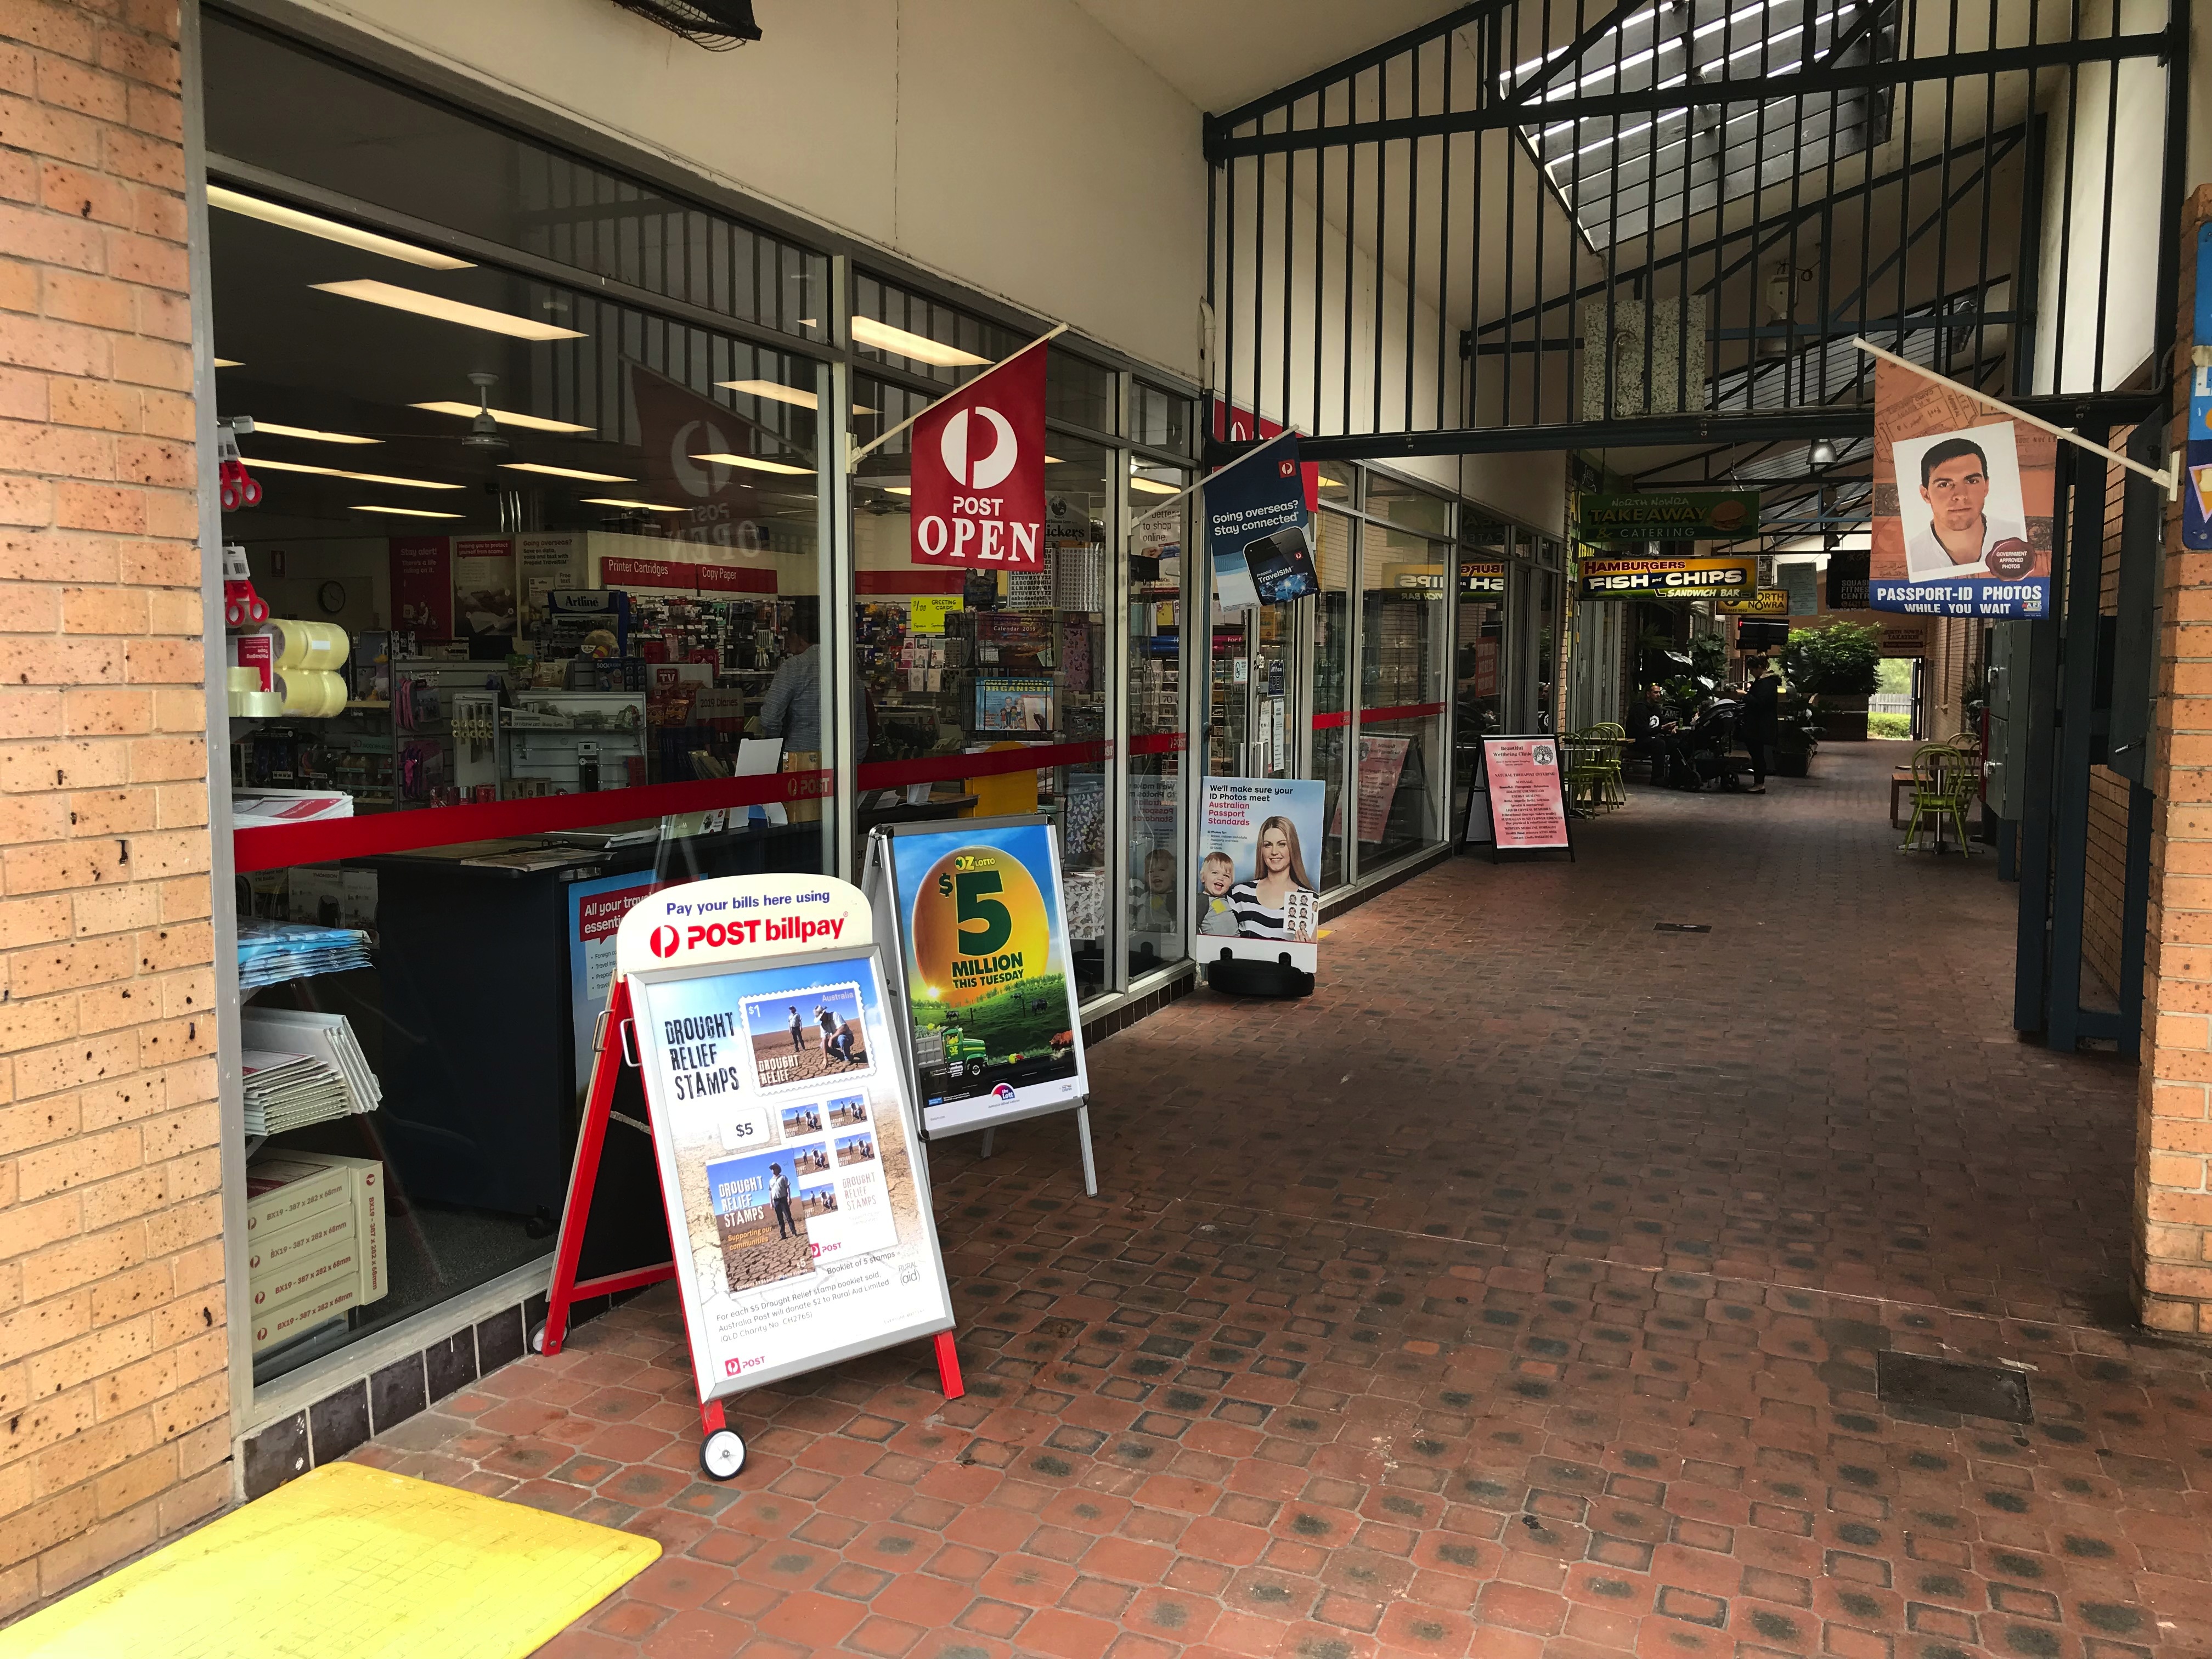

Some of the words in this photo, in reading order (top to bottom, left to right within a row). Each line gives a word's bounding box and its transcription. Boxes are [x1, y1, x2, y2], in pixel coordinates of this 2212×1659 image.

[953, 496, 1003, 516] POST
[1612, 498, 1647, 507] NORTH
[1651, 496, 1689, 506] NOWRA
[1212, 511, 1243, 524] Going
[1245, 500, 1299, 518] overseas?
[1153, 522, 1172, 531] shop
[1215, 524, 1239, 536] Stay
[1596, 527, 1613, 539] &
[1620, 527, 1695, 538] CATERING
[917, 515, 1040, 563] OPEN
[1143, 533, 1168, 542] online.
[400, 549, 416, 557] Stay
[608, 560, 632, 572] Printer
[634, 561, 668, 577] Cartridges
[702, 567, 718, 580] Copy
[720, 569, 736, 580] Paper
[1258, 567, 1292, 583] TravelSIM
[1584, 561, 1685, 574] HAMBURGERS
[1588, 574, 1649, 590] FISH
[1665, 571, 1742, 585] CHIPS
[1667, 589, 1717, 597] SANDWICH
[1720, 589, 1740, 597] BAR
[1877, 587, 1973, 601] PASSPORT-ID
[1983, 585, 2042, 601] PHOTOS
[566, 596, 599, 607] Artline
[1748, 600, 1784, 610] NOWRA
[1904, 603, 1941, 613] WHILE
[1948, 603, 1972, 613] YOU
[1979, 603, 2011, 614] WAIT
[659, 674, 675, 682] TV
[701, 698, 715, 707] 2019
[717, 697, 738, 707] Diaries
[800, 777, 830, 794] POST
[955, 856, 975, 871] OZ
[975, 857, 996, 867] LOTTO
[585, 902, 597, 917] All
[600, 900, 622, 916] your
[667, 902, 692, 916] Pay
[698, 901, 728, 915] your
[732, 896, 759, 909] bills
[764, 894, 792, 906] here
[796, 891, 830, 905] using
[688, 919, 761, 950] POST
[766, 916, 844, 943] billpay
[951, 952, 1024, 979] MILLION
[953, 978, 978, 989] THIS
[980, 969, 1024, 986] TUESDAY
[822, 991, 854, 1002] Australia
[748, 1005, 760, 1018] $1
[665, 1012, 736, 1044] DROUGHT
[670, 1043, 717, 1070] RELIEF
[759, 1054, 799, 1071] DROUGHT
[675, 1066, 740, 1101] STAMPS
[760, 1071, 790, 1085] RELIEF
[736, 1122, 753, 1137] $5
[719, 1176, 764, 1198] DROUGHT
[842, 1172, 876, 1189] DROUGHT
[845, 1186, 867, 1199] RELIEF
[267, 1209, 284, 1221] BX19
[289, 1202, 301, 1212] 387
[307, 1196, 318, 1205] 282
[324, 1186, 342, 1197] 68mm
[721, 1194, 752, 1212] RELIEF
[847, 1195, 877, 1211] STAMPS
[724, 1206, 764, 1228] STAMPS
[270, 1246, 287, 1259] BX19
[294, 1239, 306, 1249] 387
[311, 1232, 323, 1242] 282
[329, 1221, 347, 1234] 68mm
[728, 1229, 760, 1242] Supporting
[730, 1237, 769, 1250] communities
[822, 1243, 842, 1253] POST
[827, 1262, 854, 1275] Booklet
[870, 1250, 895, 1264] stamps
[898, 1261, 918, 1272] RURAL
[275, 1282, 292, 1294] BX19
[298, 1274, 309, 1284] 387
[315, 1268, 327, 1278] 282
[332, 1256, 351, 1268] 68mm
[716, 1313, 730, 1322] For
[731, 1307, 748, 1317] each
[750, 1304, 760, 1313] $5
[761, 1296, 791, 1310] Drought
[792, 1289, 812, 1301] Relief
[814, 1284, 836, 1298] stamp
[838, 1276, 864, 1290] booklet
[278, 1318, 294, 1330] BX19
[300, 1311, 311, 1321] 387
[317, 1304, 329, 1313] 282
[335, 1291, 353, 1304] 68mm
[719, 1319, 752, 1332] Australia
[754, 1313, 771, 1323] Post
[772, 1308, 784, 1317] will
[785, 1300, 812, 1314] donate
[812, 1296, 822, 1306] $2
[832, 1289, 851, 1301] Rural
[852, 1285, 864, 1295] Aid
[720, 1331, 738, 1343] (QLD
[740, 1323, 768, 1337] Charity
[782, 1311, 813, 1325] CH2765)
[742, 1356, 766, 1369] POST
